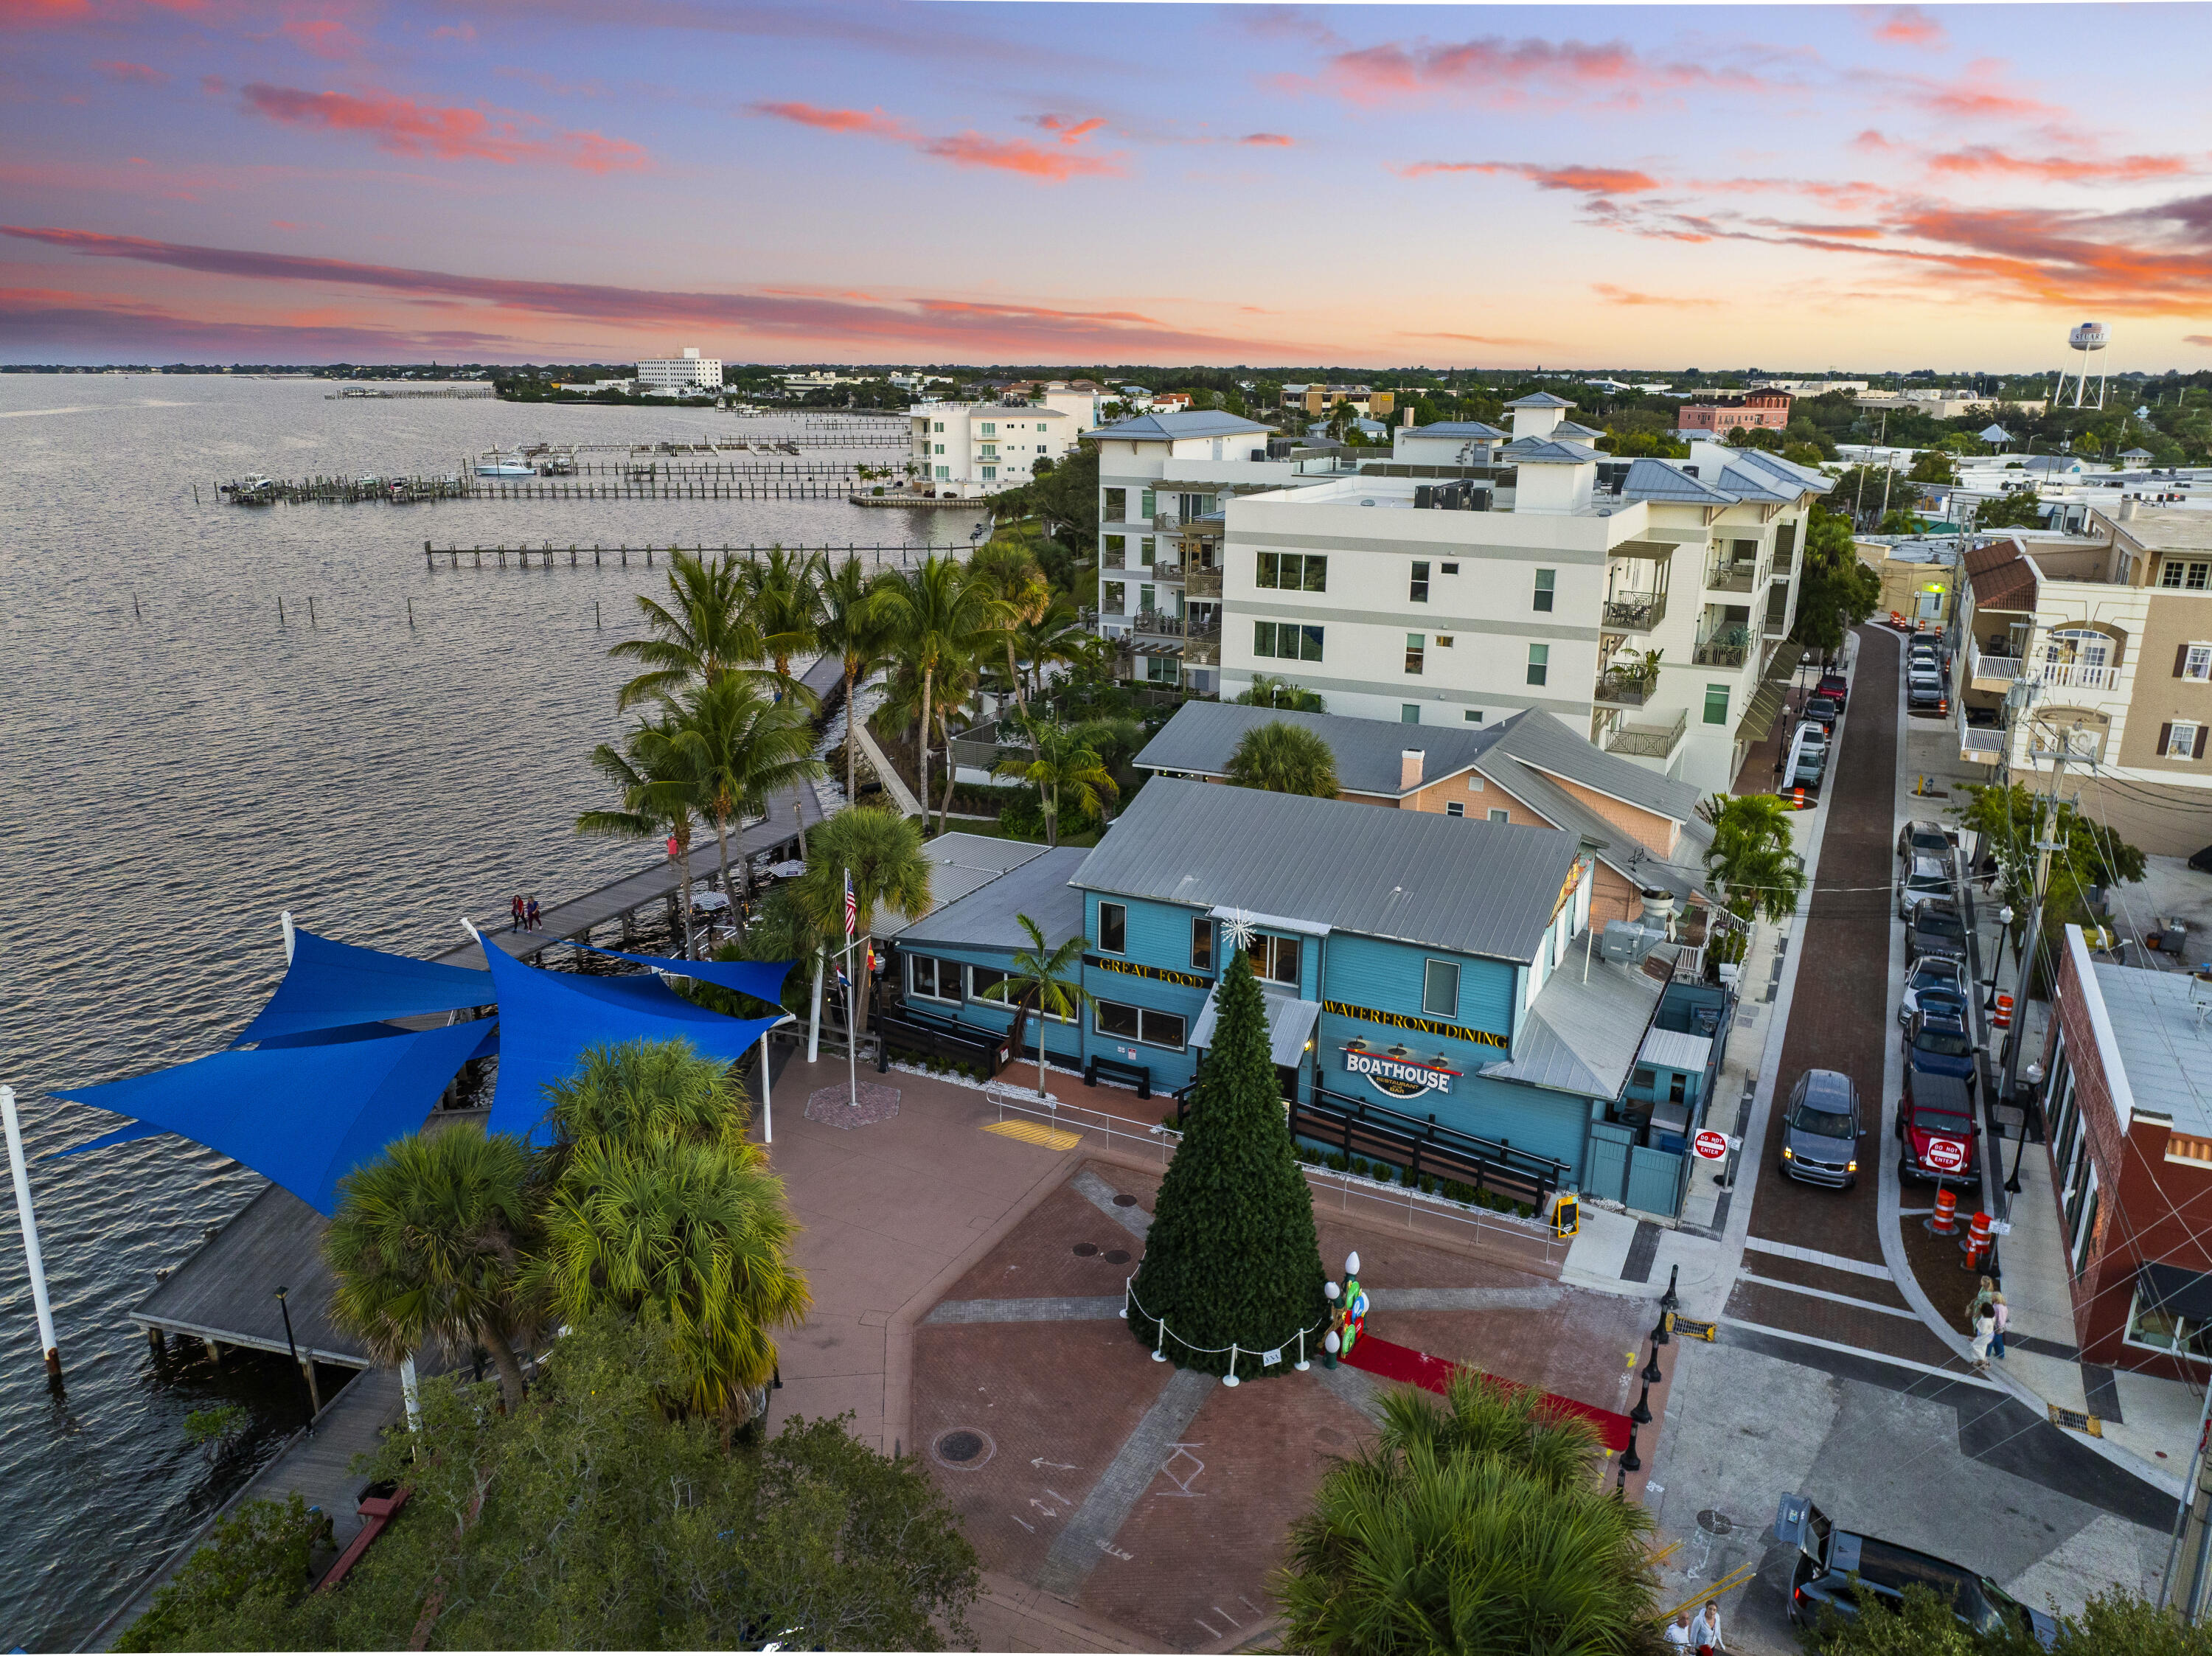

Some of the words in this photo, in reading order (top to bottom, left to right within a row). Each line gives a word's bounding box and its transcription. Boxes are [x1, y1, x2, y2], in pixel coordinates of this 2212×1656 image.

[1099, 958, 1150, 978] GREAT
[1159, 969, 1203, 989] FOOD
[1324, 1000, 1442, 1035] WATERFRONT
[1445, 1025, 1508, 1049] DINING
[1346, 1054, 1450, 1093] BOATHOUSE
[1376, 1076, 1419, 1090] RESTAURANT
